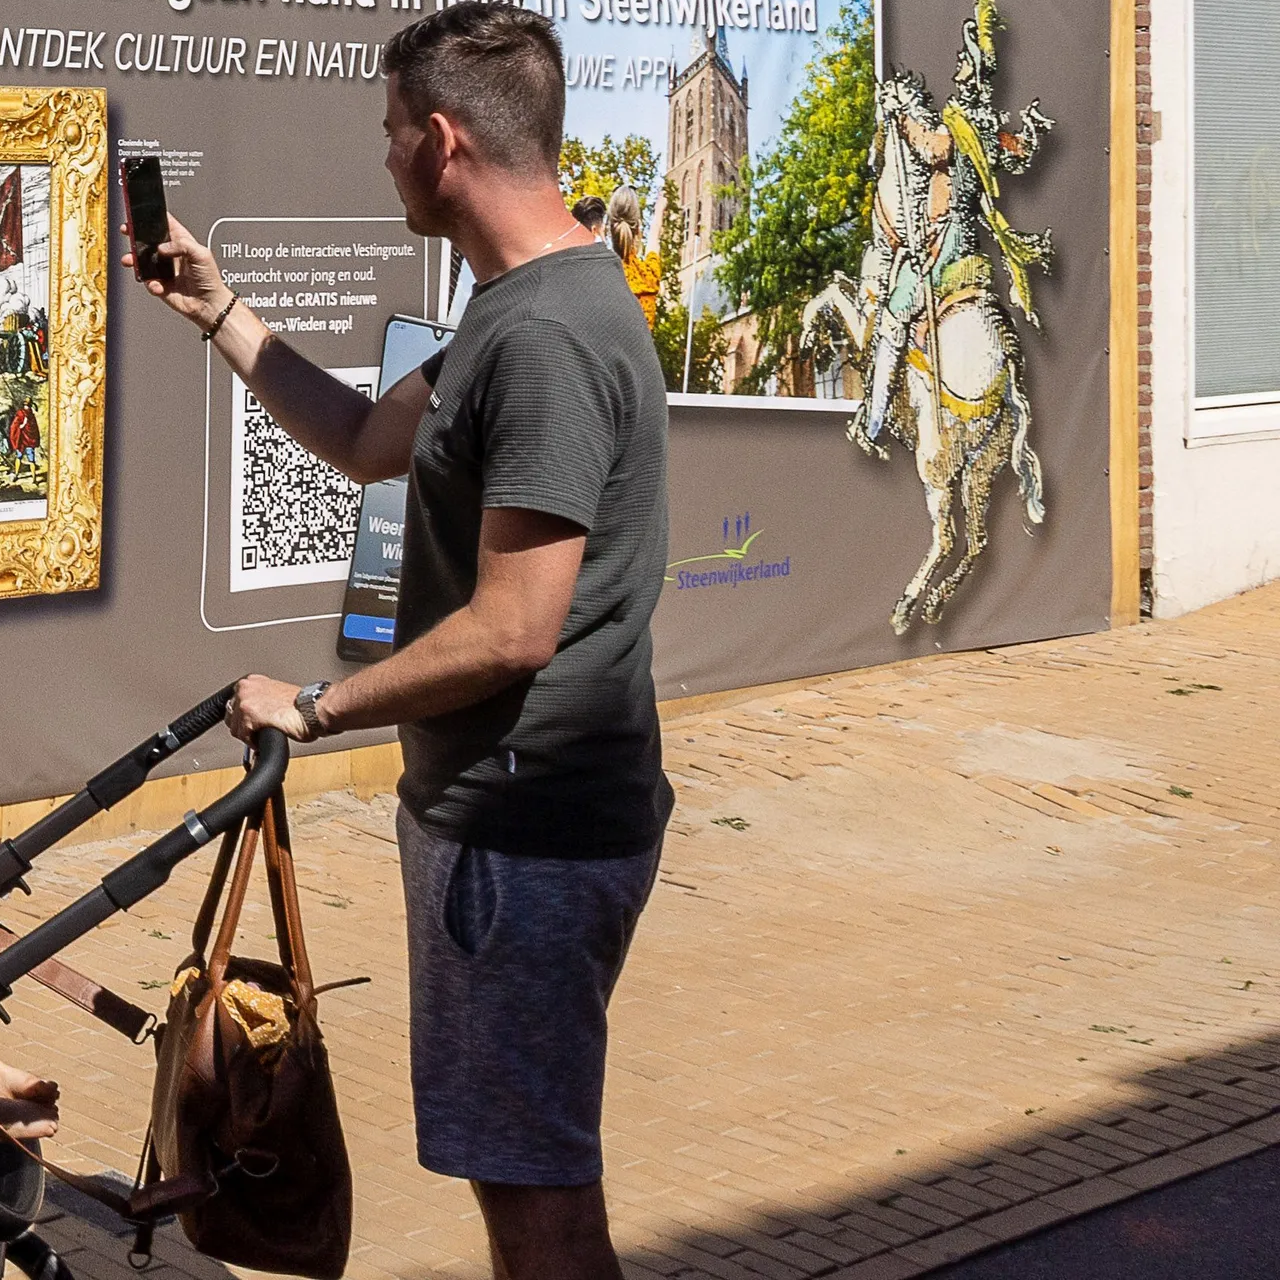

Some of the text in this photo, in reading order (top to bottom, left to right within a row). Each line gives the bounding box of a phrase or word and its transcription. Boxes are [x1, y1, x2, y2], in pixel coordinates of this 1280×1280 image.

[114, 32, 246, 75] CULTUUR
[255, 37, 297, 77] EN
[221, 243, 416, 261] TIP! Loop de interactieve Vestingroute.
[221, 266, 376, 286] Speurtocht voor jong en oud.
[279, 292, 293, 307] de
[295, 292, 338, 307] GRATIS
[340, 291, 377, 306] nieuwe
[329, 314, 353, 334] app!
[677, 556, 790, 590] Steenwijkerland
